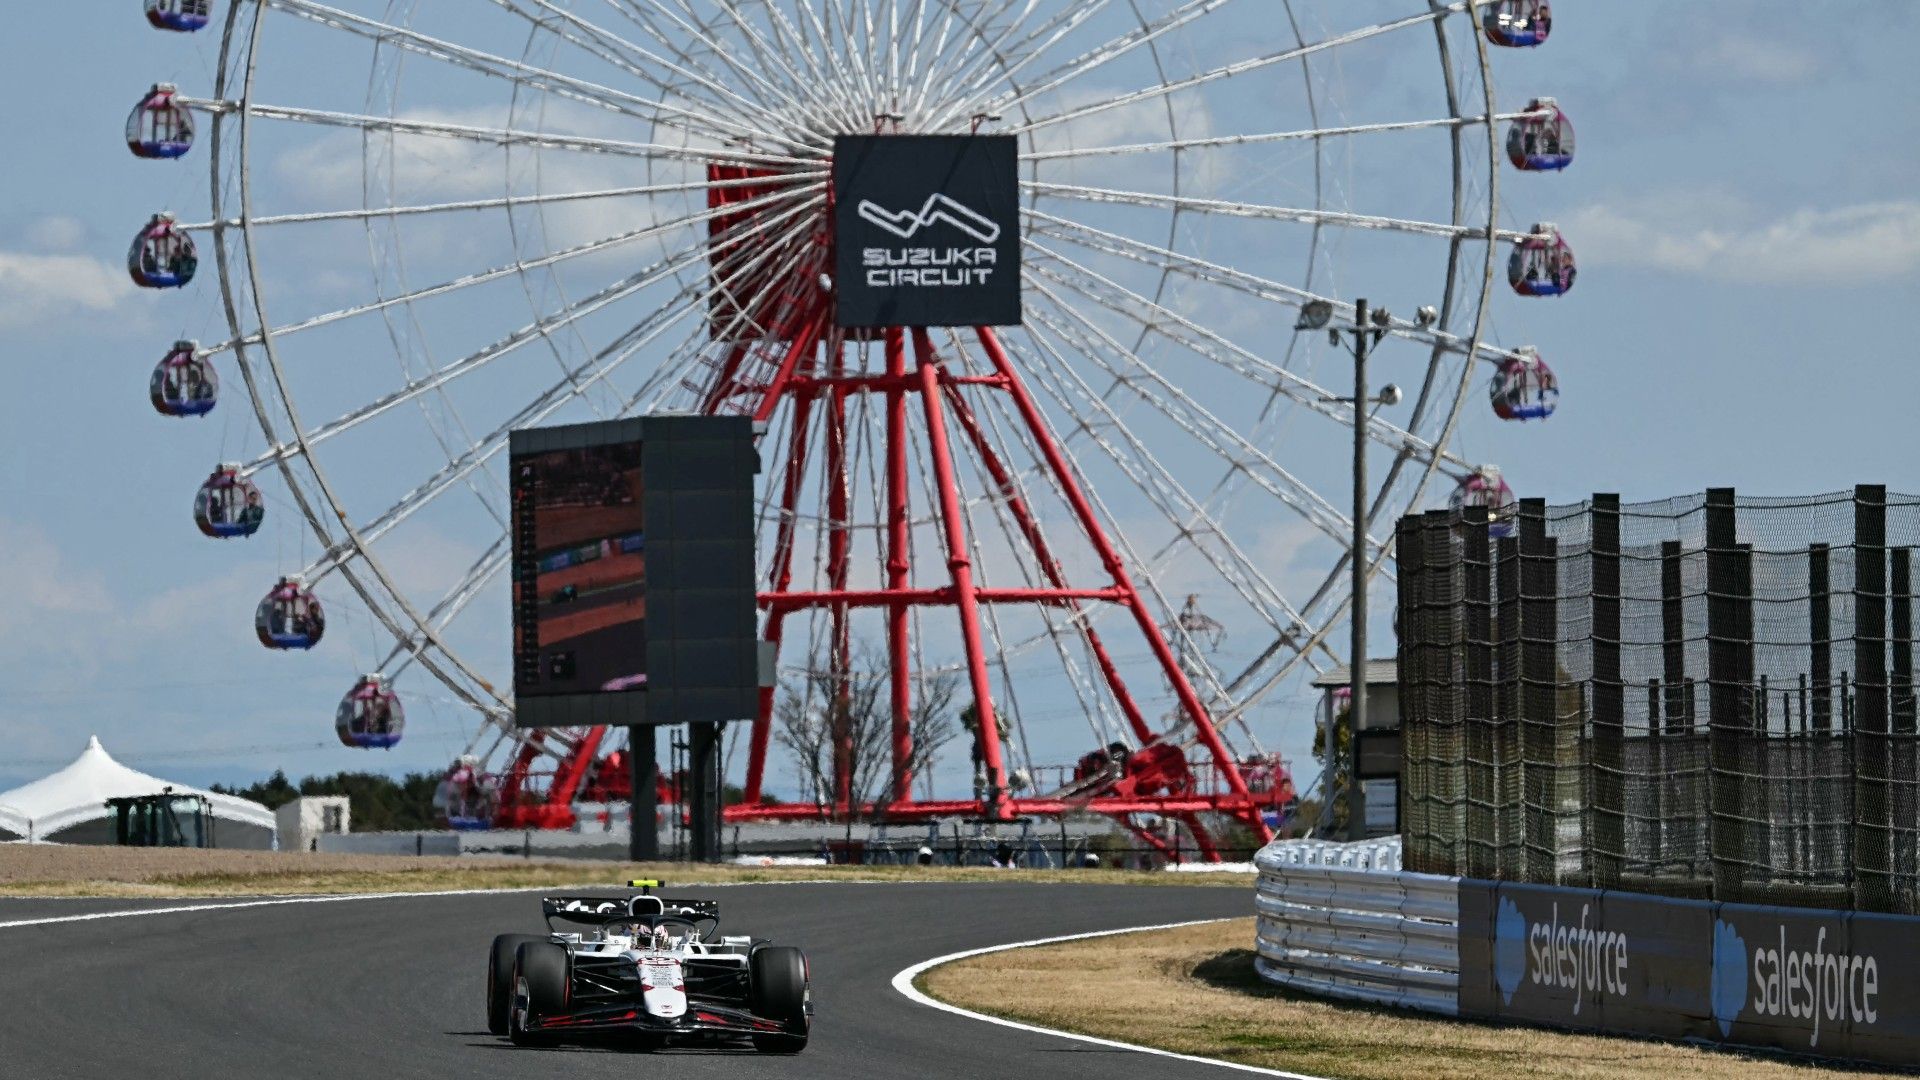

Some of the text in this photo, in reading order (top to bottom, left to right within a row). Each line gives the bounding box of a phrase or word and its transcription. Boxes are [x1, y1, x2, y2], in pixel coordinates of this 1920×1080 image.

[862, 247, 997, 266] SUZUKA
[866, 268, 993, 287] CIRCUIT
[1530, 901, 1628, 1016] salesforce
[1754, 924, 1879, 1048] salesforce
